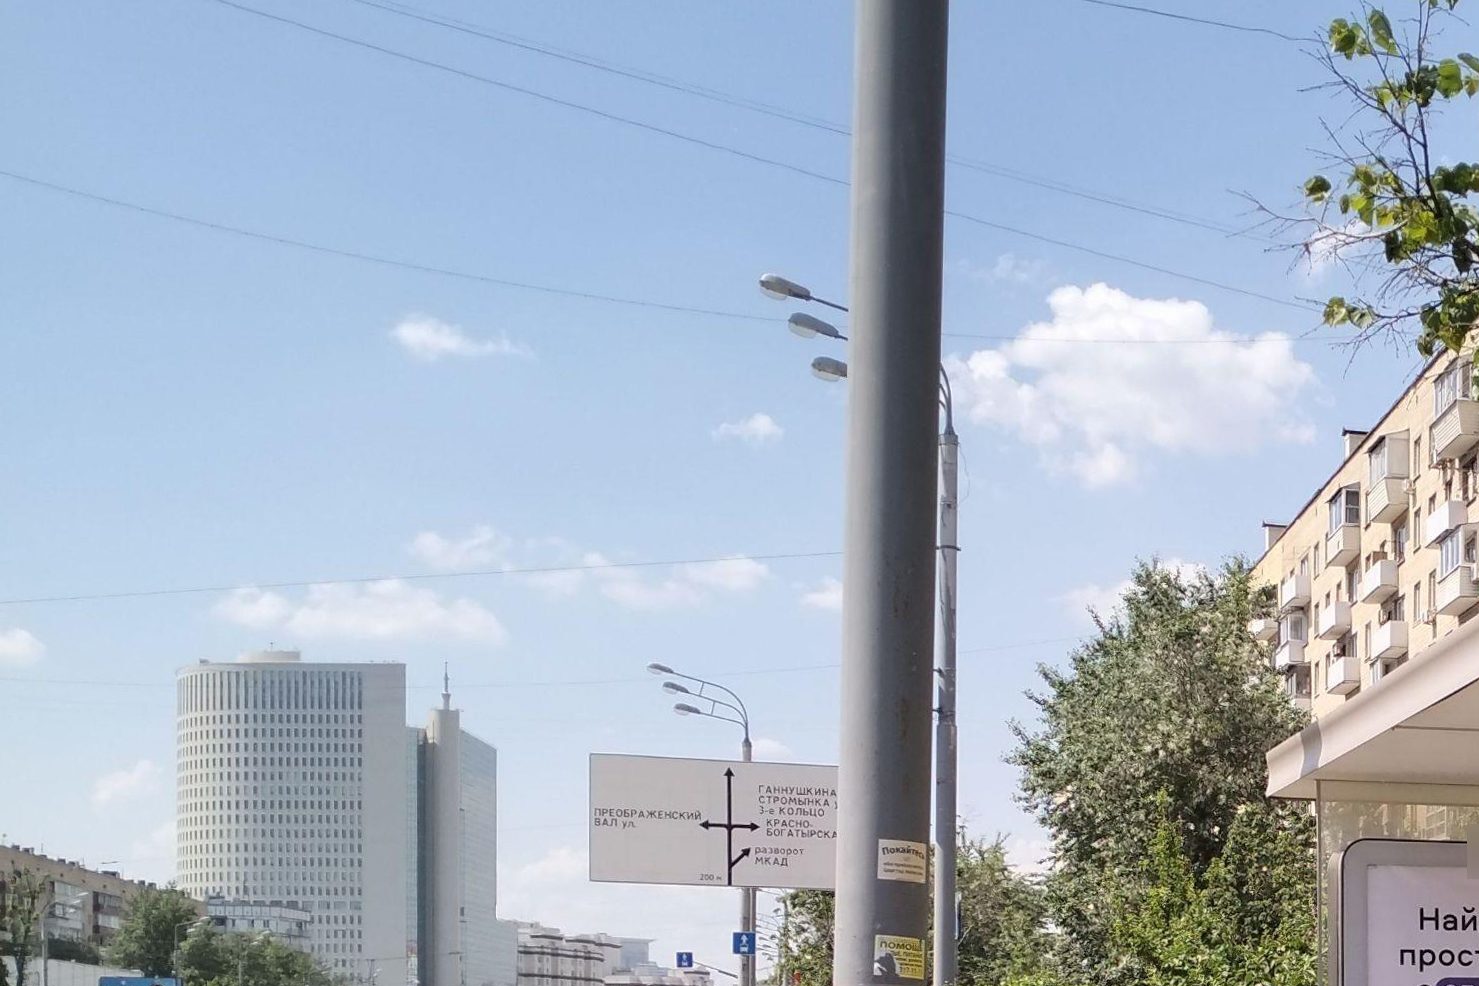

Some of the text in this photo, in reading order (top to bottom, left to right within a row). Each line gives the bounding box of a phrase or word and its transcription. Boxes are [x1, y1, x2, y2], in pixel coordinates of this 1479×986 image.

[758, 785, 837, 799] ГАННУШКИНА
[758, 796, 830, 807] СТРОМЫНКА
[594, 807, 702, 820] ПРЕОБРАЖЕНСКИЙ
[759, 806, 825, 818] 3-е КОЛЬЦО
[594, 818, 618, 826] ВАЛ
[766, 819, 813, 829] КРАСНО-
[754, 846, 804, 856] разворот
[754, 857, 789, 867] МКАД
